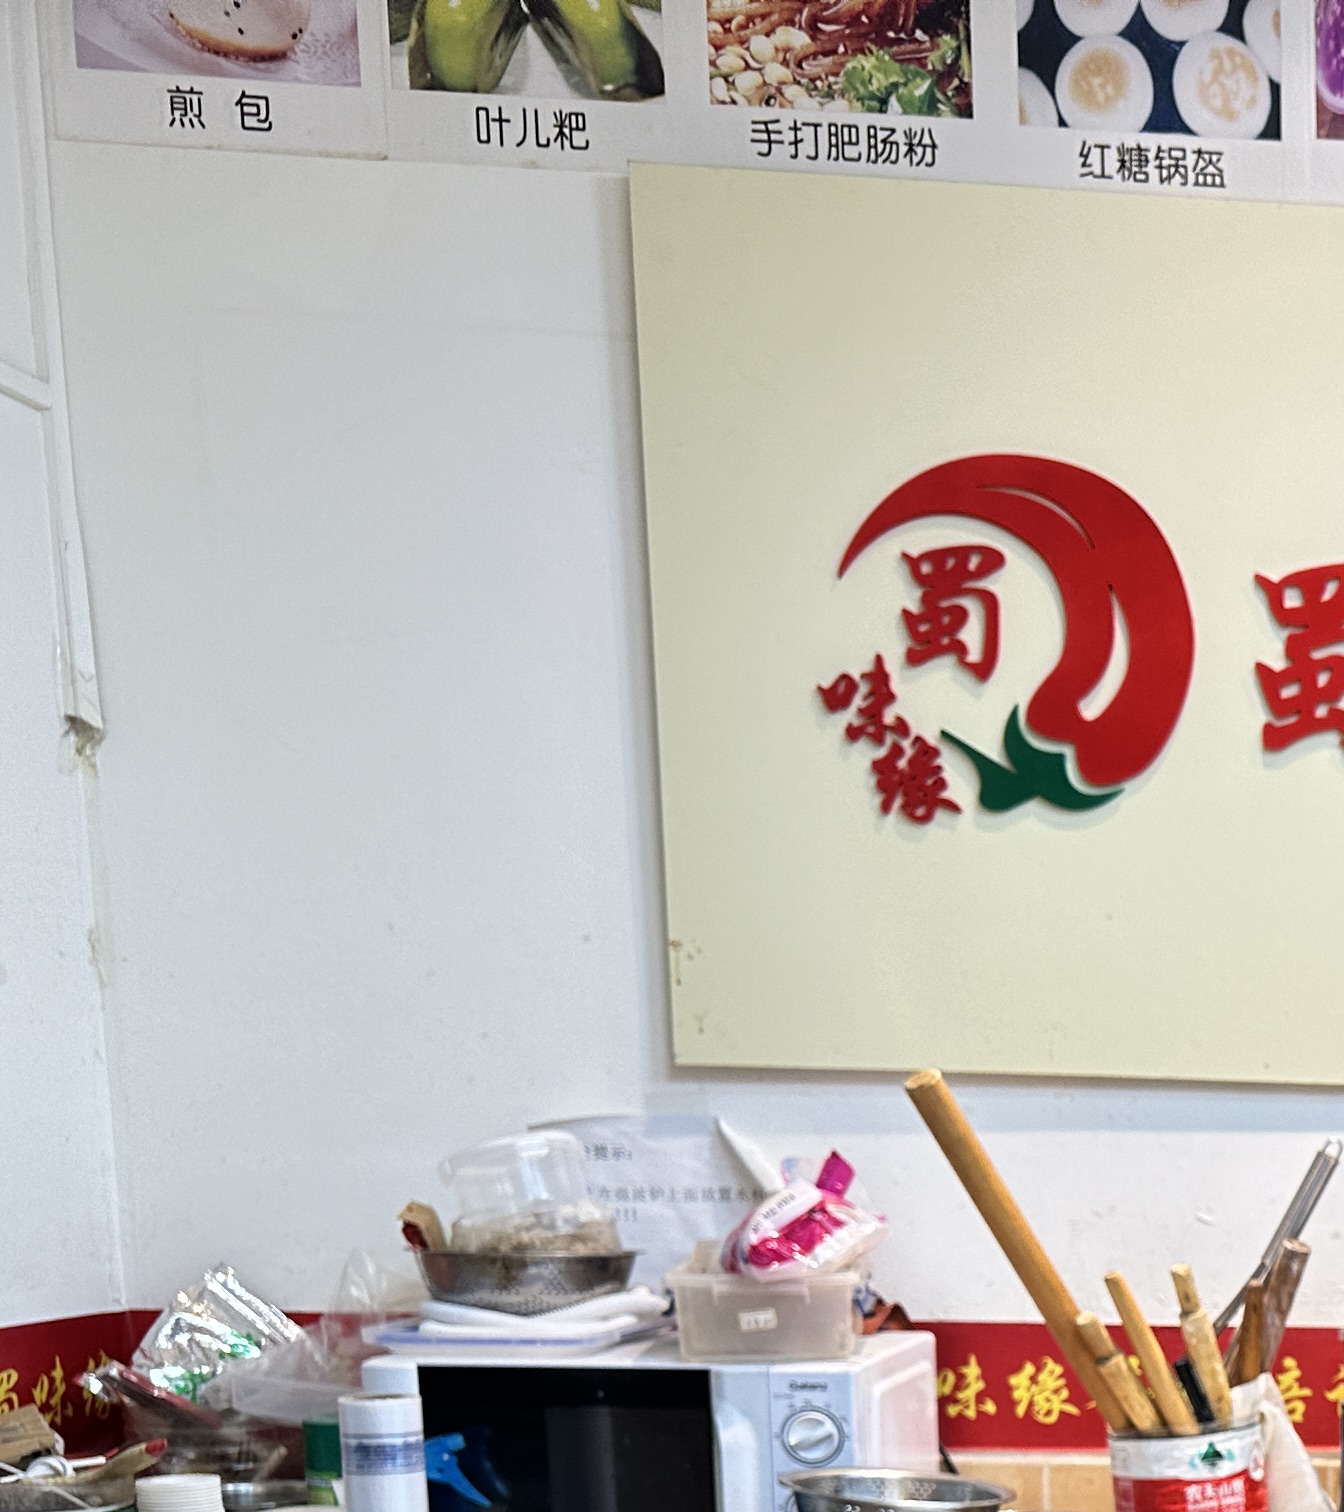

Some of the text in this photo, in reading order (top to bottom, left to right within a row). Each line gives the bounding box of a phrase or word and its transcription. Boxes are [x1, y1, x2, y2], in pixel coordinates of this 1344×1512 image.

[166, 86, 273, 132] 煎包
[475, 106, 590, 151] 叶儿粑
[749, 119, 939, 169] 手打肥肠粉
[1078, 141, 1228, 189] 红糖锅盔
